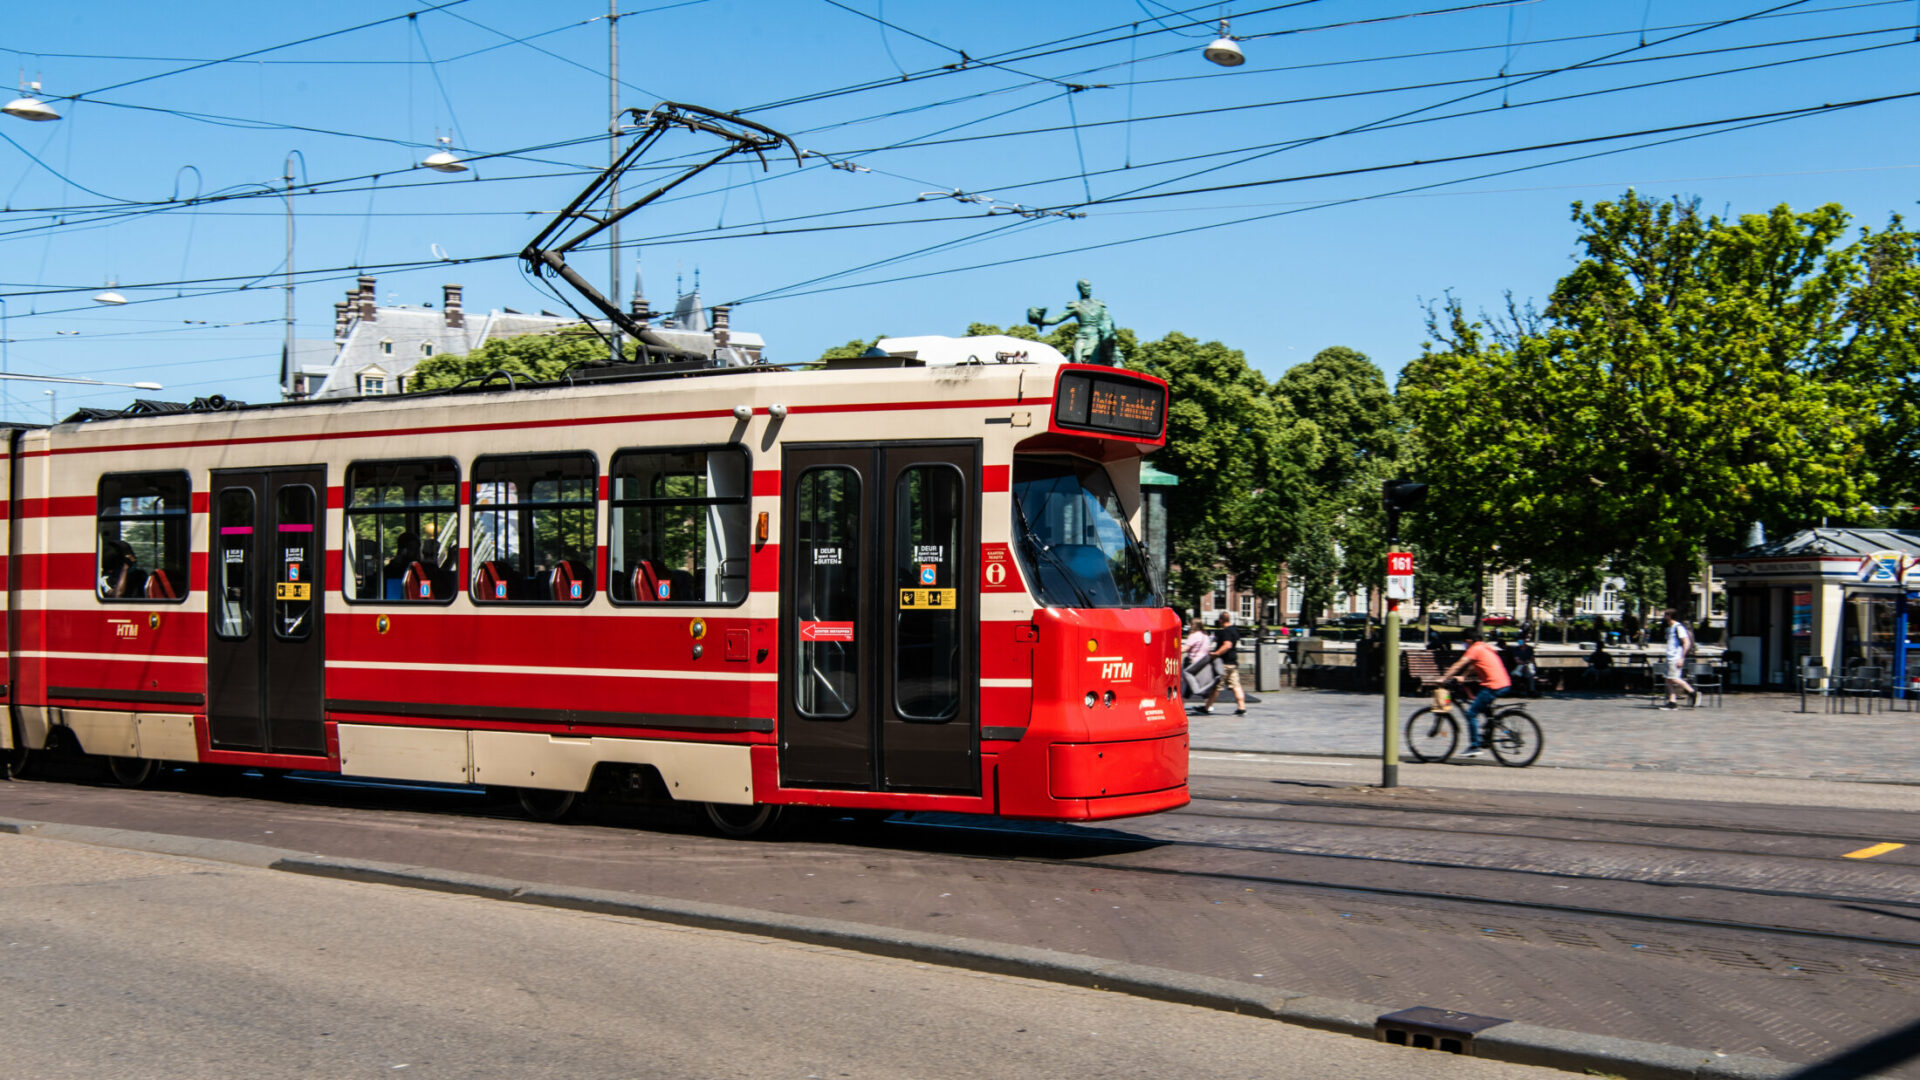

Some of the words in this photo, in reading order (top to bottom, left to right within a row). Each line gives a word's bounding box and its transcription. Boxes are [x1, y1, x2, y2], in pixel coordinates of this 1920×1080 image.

[1391, 557, 1411, 570] 161
[116, 624, 139, 637] HTM
[1102, 662, 1133, 678] HTM
[1164, 657, 1179, 676] 3111
